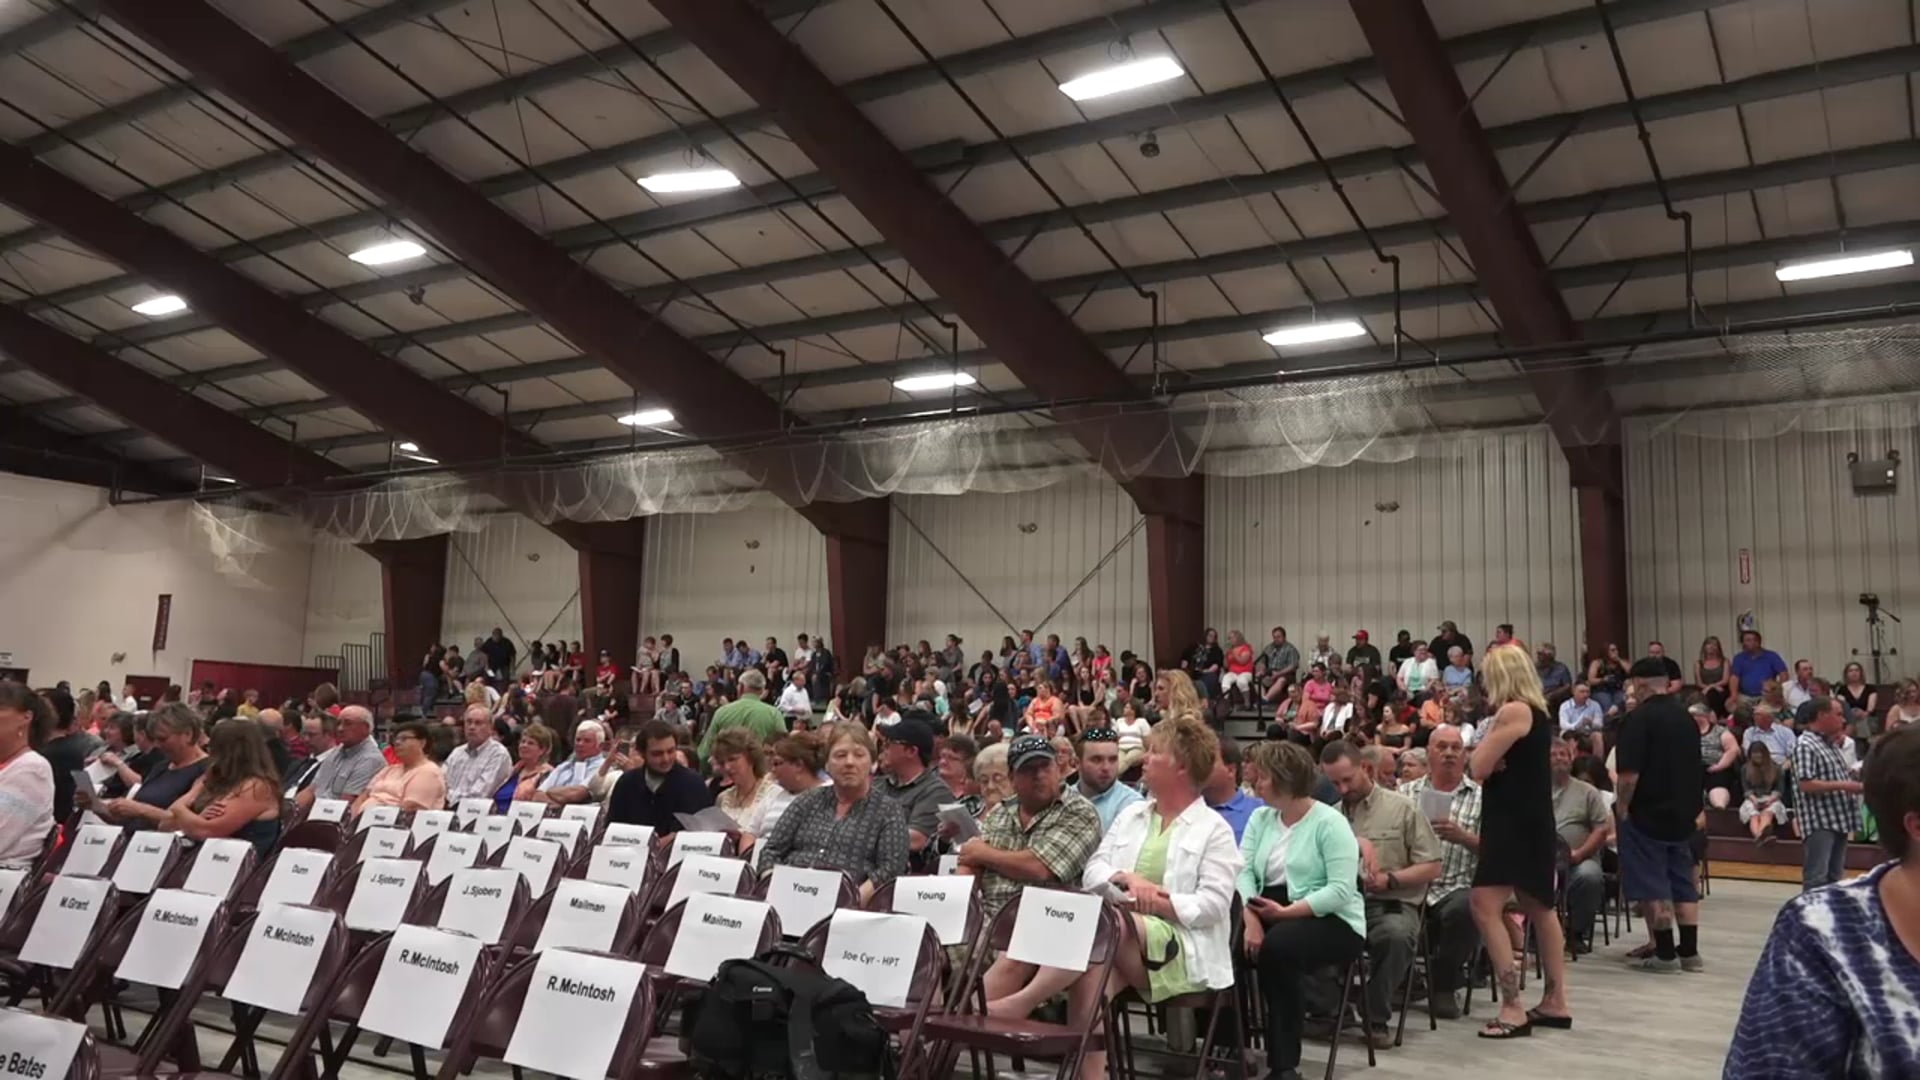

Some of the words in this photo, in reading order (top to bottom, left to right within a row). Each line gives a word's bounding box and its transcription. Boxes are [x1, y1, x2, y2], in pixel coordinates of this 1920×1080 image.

[380, 840, 394, 850] Young
[449, 844, 466, 855] Young
[523, 851, 542, 863] Young
[291, 863, 309, 874] Dunn
[609, 860, 630, 869] Young
[699, 869, 720, 882] Young
[462, 886, 501, 898] J.Sjoberg
[793, 883, 818, 896] Young
[918, 891, 945, 901] Young
[60, 897, 89, 910] M.Grant
[570, 898, 605, 912] Mailman
[153, 909, 198, 926] R.McIntosh
[702, 913, 742, 928] Mailman
[1045, 906, 1074, 922] Young
[263, 925, 314, 946] R.McIntosh
[399, 949, 459, 975] R.McIntosh
[842, 950, 858, 961] Joe
[860, 952, 875, 965] Cyr
[882, 957, 900, 966] HPT
[547, 976, 615, 1002] R.McIntosh
[7, 1052, 46, 1079] Bates
